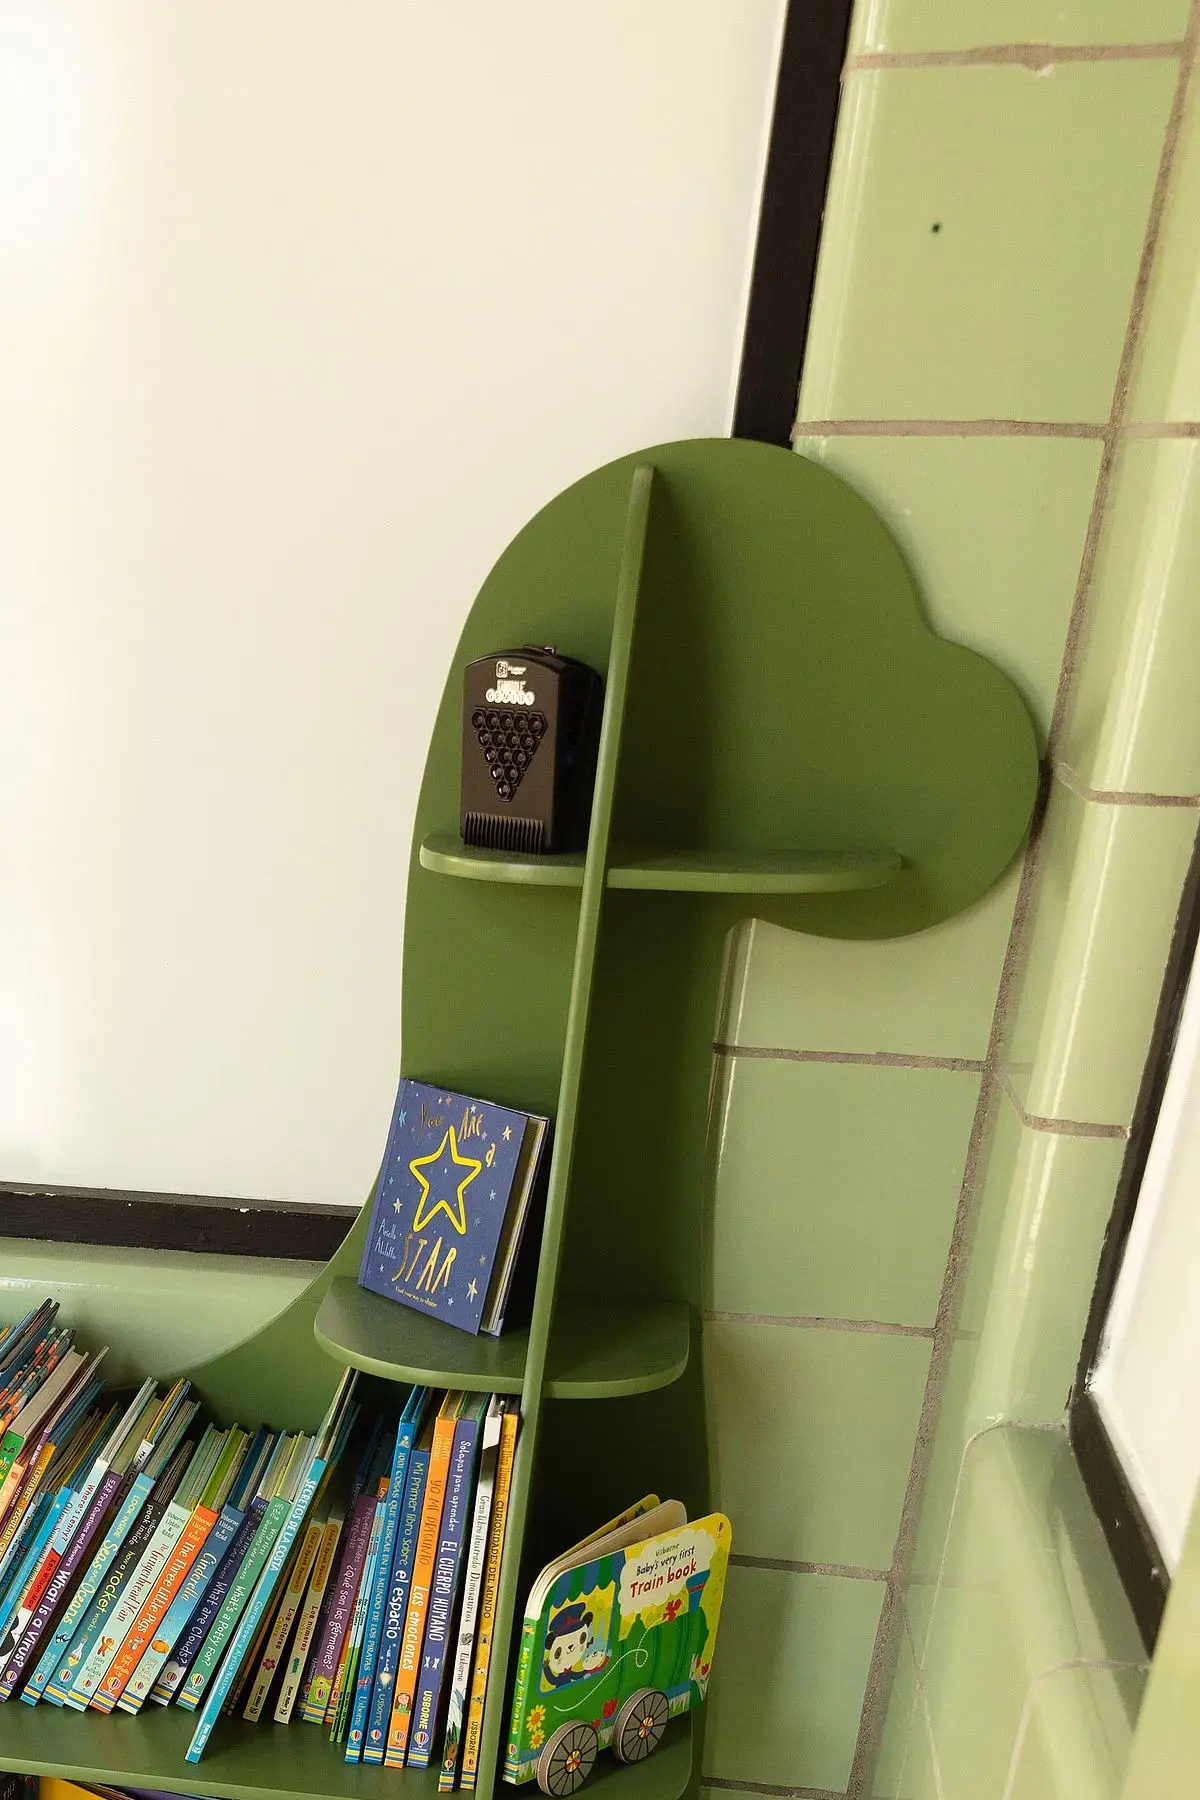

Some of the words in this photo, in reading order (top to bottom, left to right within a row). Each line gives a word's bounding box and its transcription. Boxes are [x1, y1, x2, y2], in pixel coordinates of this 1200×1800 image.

[392, 1233, 458, 1295] STAR
[412, 1461, 424, 1475] Mi
[73, 1482, 95, 1515] Where's
[290, 1477, 316, 1520] SECRETOS
[404, 1476, 421, 1511] primer
[59, 1513, 79, 1542] Lenny?
[284, 1519, 298, 1534] DE
[402, 1512, 416, 1536] libro
[488, 1500, 504, 1564] CURIOSIDADES
[177, 1539, 195, 1560] The
[279, 1532, 292, 1546] LA
[397, 1537, 412, 1566] sobre
[441, 1540, 456, 1554] EL
[655, 1543, 680, 1557] Usborne
[91, 1538, 118, 1572] Seas
[121, 1549, 135, 1565] how
[268, 1545, 287, 1572] COSTA
[636, 1561, 661, 1577] Baby's
[660, 1554, 678, 1573] very
[679, 1545, 695, 1563] first
[43, 1567, 70, 1603] What
[124, 1547, 165, 1604] Gingerbread
[161, 1556, 186, 1589] Three
[179, 1550, 217, 1605] Cinderella
[340, 1563, 357, 1588] ¿Qué
[393, 1569, 409, 1585] el
[434, 1556, 454, 1595] CUERPO
[486, 1566, 497, 1583] DEL
[630, 1574, 664, 1600] Train
[666, 1559, 698, 1585] book
[61, 1580, 96, 1628] Oceans
[94, 1568, 126, 1614] rocket
[147, 1586, 171, 1615] Little
[204, 1579, 227, 1609] What
[224, 1583, 245, 1613] What's
[336, 1589, 349, 1606] son
[410, 1585, 427, 1608] Las
[482, 1585, 495, 1619] MUNDO
[30, 1617, 42, 1628] a
[36, 1603, 52, 1618] is
[86, 1612, 100, 1632] works
[115, 1601, 137, 1625] Man
[134, 1611, 156, 1635] Pigs
[195, 1606, 211, 1625] are
[221, 1612, 230, 1620] a
[333, 1607, 347, 1620] los
[382, 1586, 405, 1639] espacio
[427, 1596, 448, 1642] HUMANO
[174, 1624, 204, 1665] Clouds?
[207, 1619, 228, 1646] Potty
[318, 1621, 342, 1670] gérmenes?
[401, 1610, 422, 1670] emociones
[11, 1628, 39, 1668] Virus?
